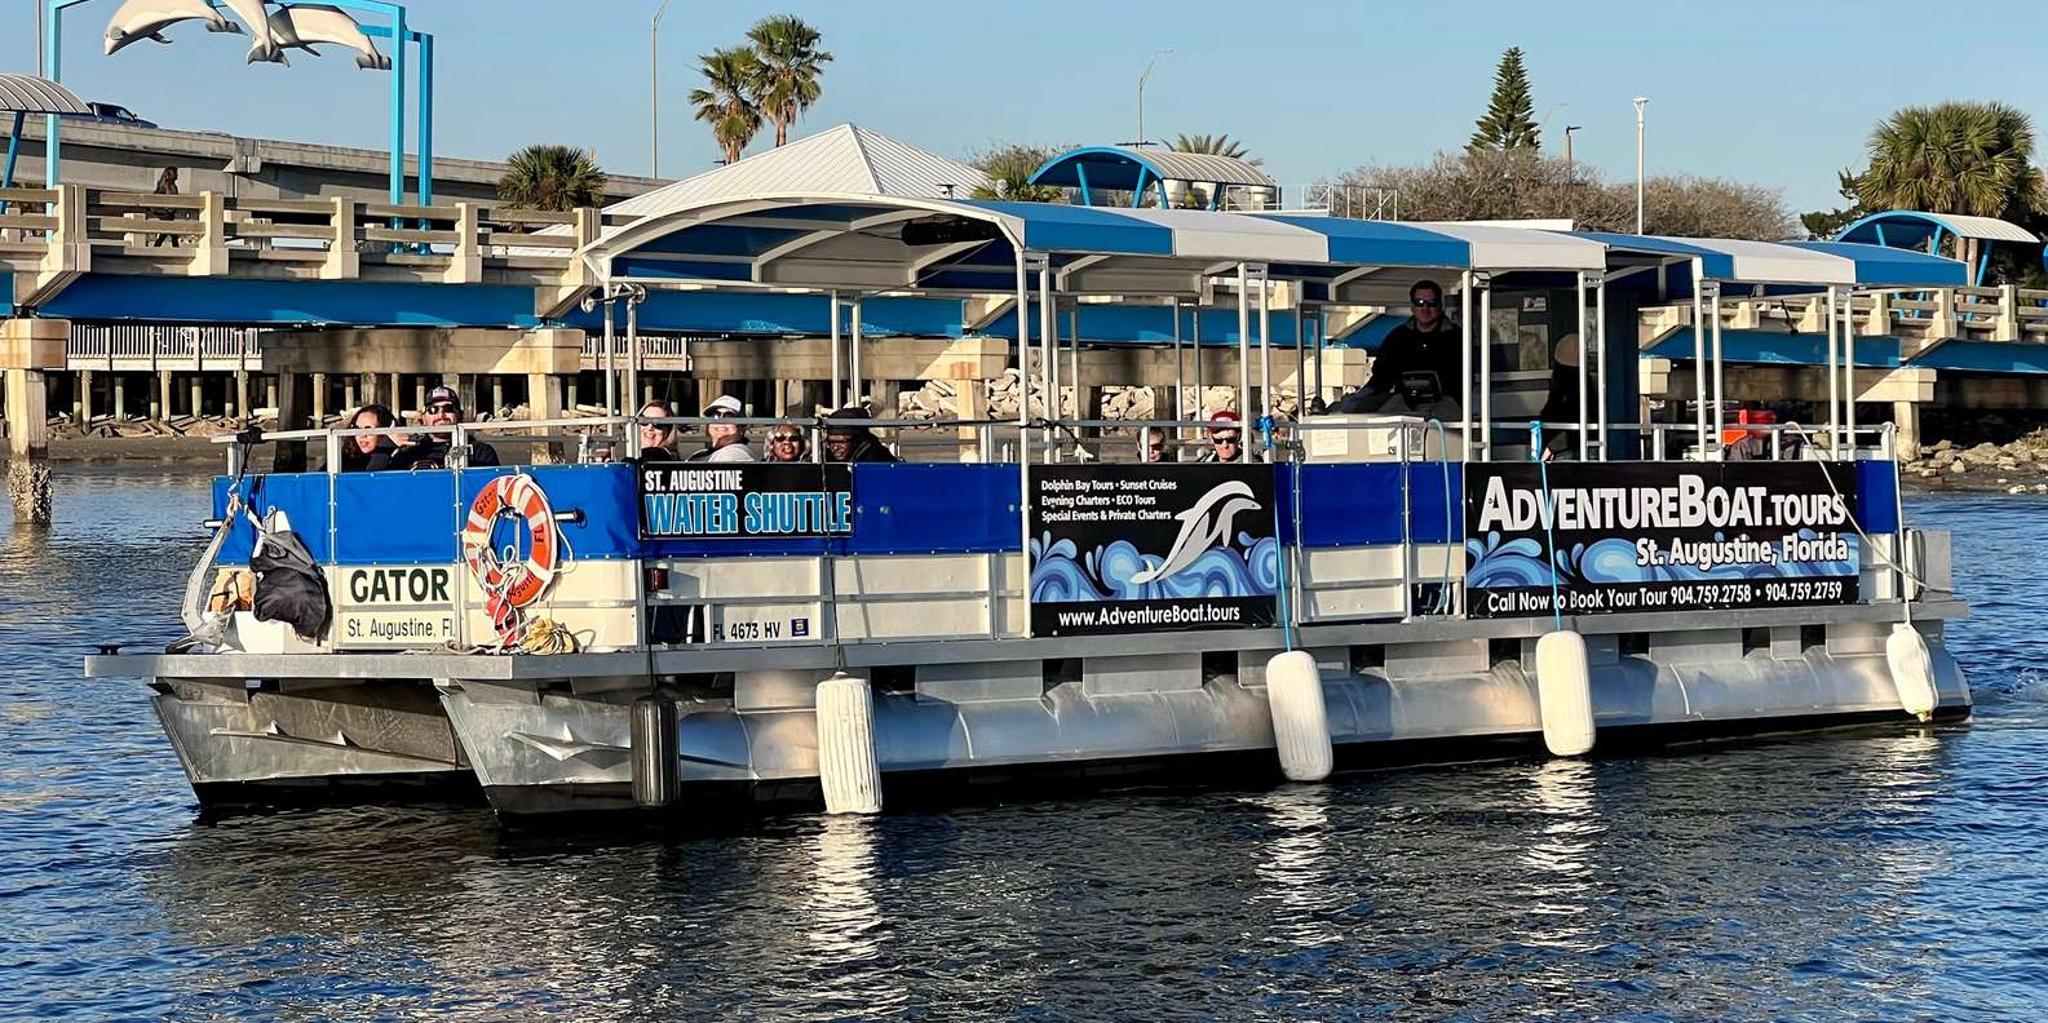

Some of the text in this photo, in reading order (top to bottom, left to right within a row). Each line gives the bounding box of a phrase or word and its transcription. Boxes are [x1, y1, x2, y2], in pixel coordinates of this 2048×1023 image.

[644, 470, 743, 491] ST. AUGUSTINE
[1041, 479, 1178, 493] Dolphin Bay Tours Sunset Cruises
[1041, 495, 1156, 508] Evening Charters ECO Tours
[645, 492, 851, 534] WATER SHUTTLE
[1042, 509, 1172, 523] Special Events & Private Charters
[1636, 531, 1848, 571] St. Augustine, Florida
[350, 568, 450, 603] GATOR
[1487, 592, 1516, 612] Call
[1519, 591, 1550, 610] Now
[1570, 590, 1605, 609] Book
[1607, 588, 1637, 607] Your
[1639, 587, 1668, 606] Tour
[1670, 584, 1751, 604] 904.759.2758
[1765, 581, 1842, 602] 904.759.2759
[1058, 603, 1240, 626] www.AdventureBoat.tours
[347, 618, 364, 637] St.
[713, 623, 725, 640] FL
[730, 622, 759, 639] 4673
[764, 621, 780, 638] HV
